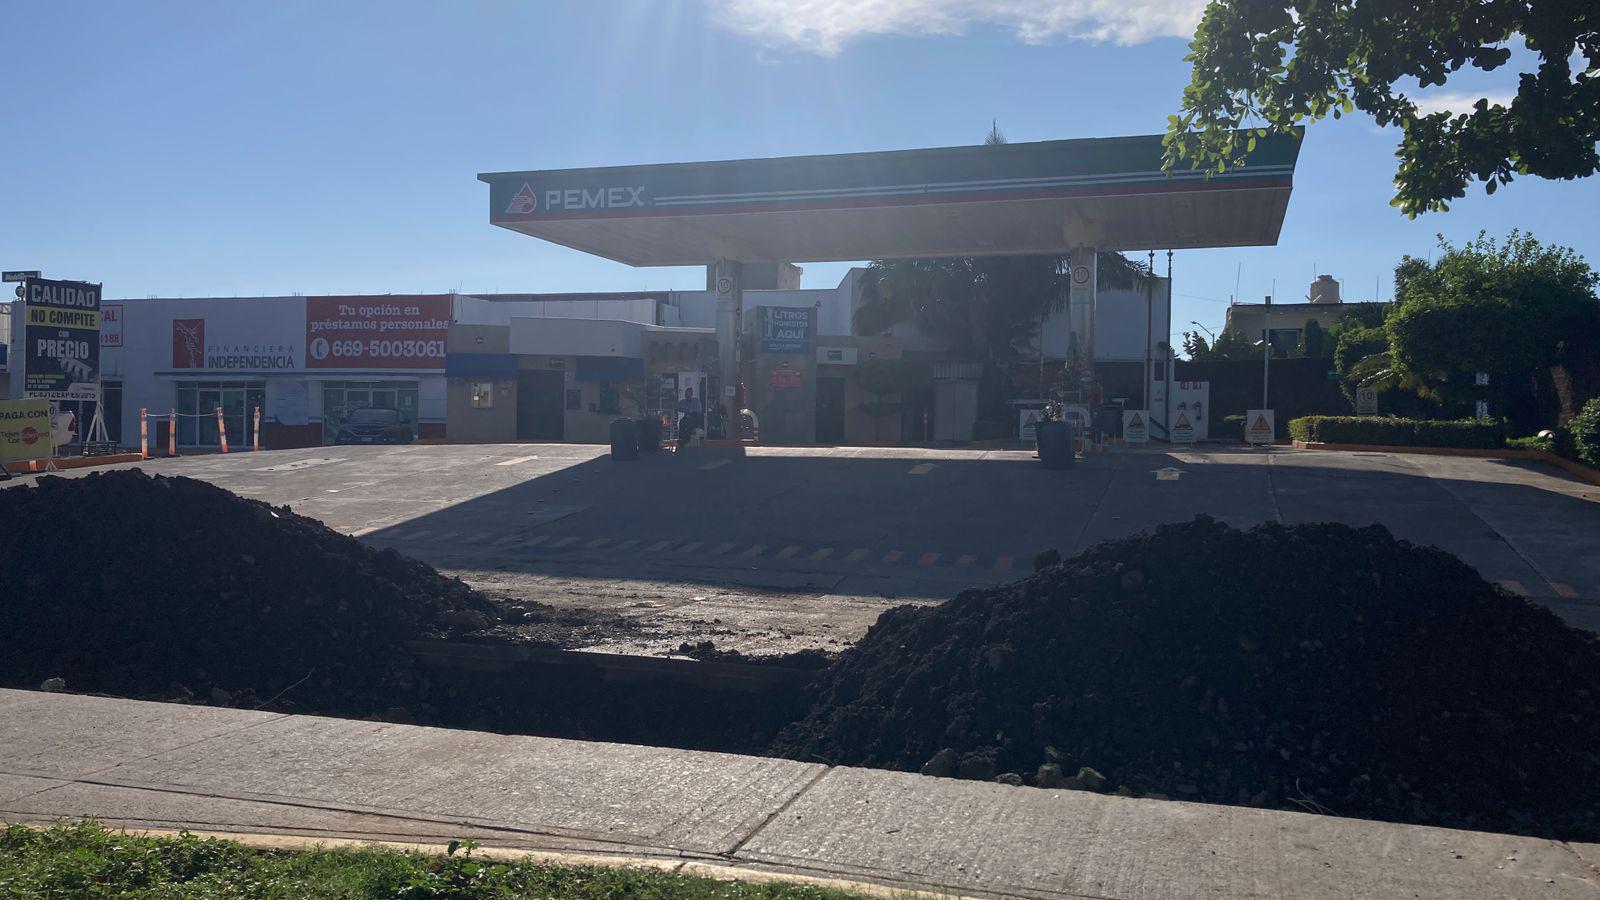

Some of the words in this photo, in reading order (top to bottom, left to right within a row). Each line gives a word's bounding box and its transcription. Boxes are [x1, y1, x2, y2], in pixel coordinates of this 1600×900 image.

[545, 186, 645, 210] PEMEX
[31, 285, 96, 307] CALIDAD
[31, 309, 45, 322] NO
[49, 310, 96, 327] COMPITE
[339, 305, 355, 316] Tu
[359, 304, 400, 318] opción
[404, 306, 420, 315] en
[774, 311, 808, 320] LITROS
[311, 319, 377, 332] préstamos
[380, 318, 449, 331] personales
[38, 339, 89, 359] PRECIO
[208, 345, 294, 353] FINANCIERA
[332, 340, 446, 358] 669-5003061
[208, 355, 295, 369] INDEPENDENCIA
[27, 410, 48, 418] CON
